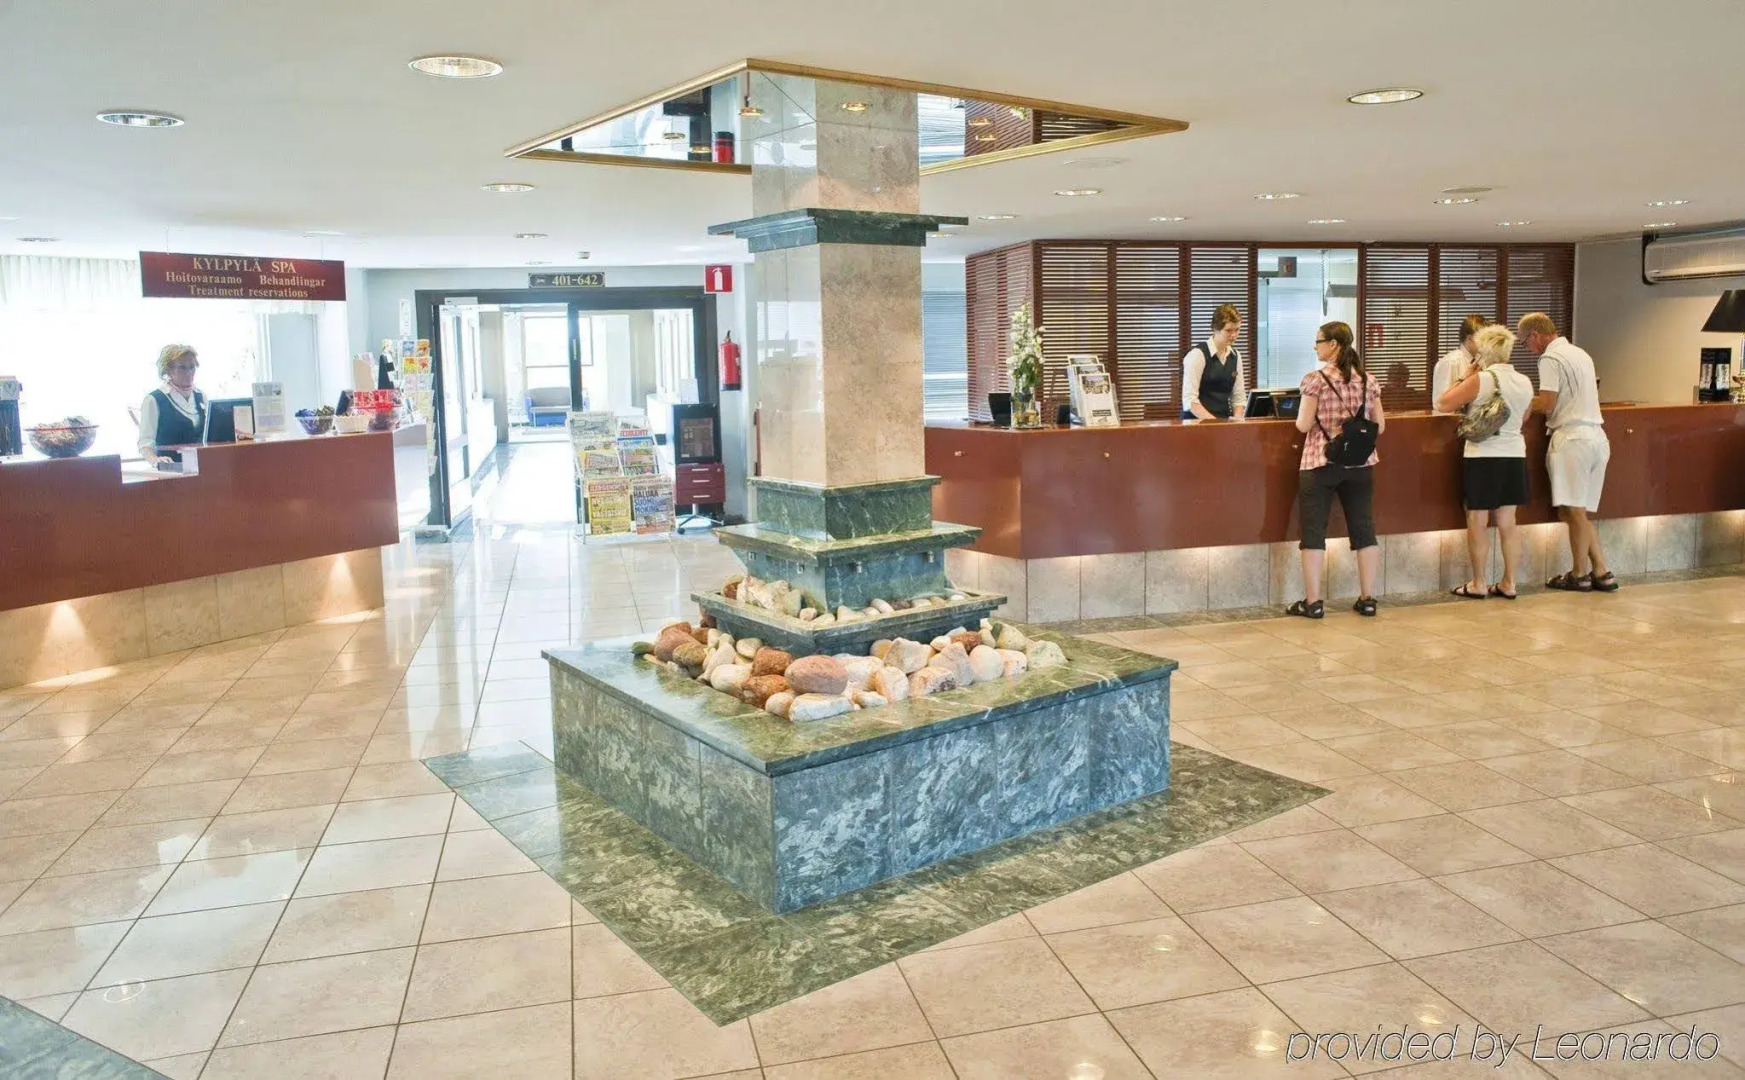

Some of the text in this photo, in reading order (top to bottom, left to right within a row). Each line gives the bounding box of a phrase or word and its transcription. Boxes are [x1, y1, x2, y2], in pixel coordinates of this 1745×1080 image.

[193, 257, 297, 274] KYLPYLÄ SPA
[165, 271, 326, 289] Hoitovaraamo Behandlingar
[552, 274, 598, 286] 401-642
[187, 284, 308, 299] Treatment reservations
